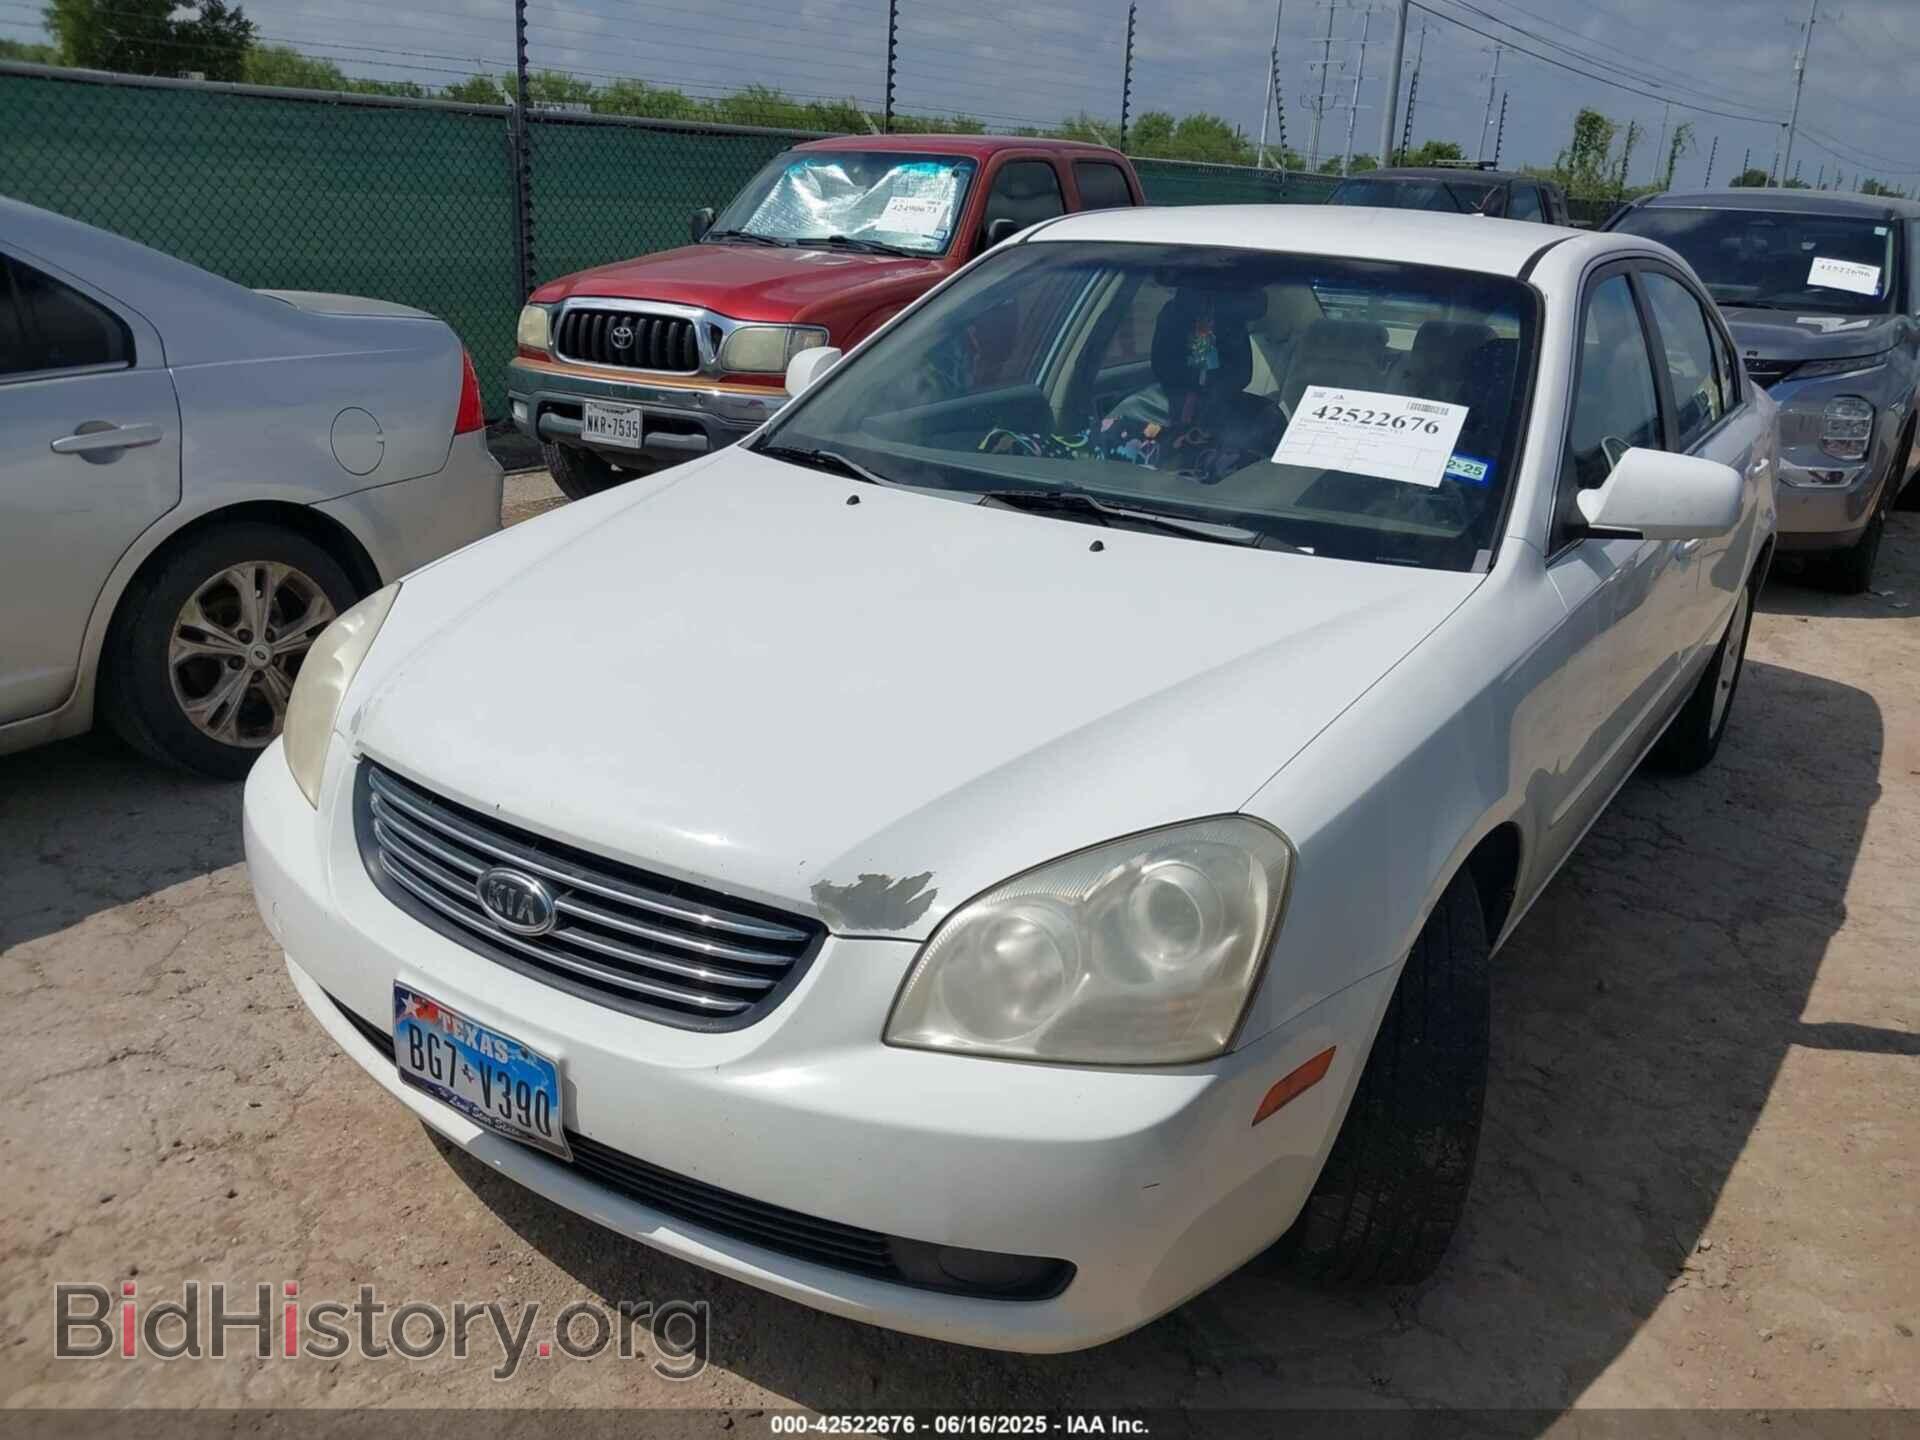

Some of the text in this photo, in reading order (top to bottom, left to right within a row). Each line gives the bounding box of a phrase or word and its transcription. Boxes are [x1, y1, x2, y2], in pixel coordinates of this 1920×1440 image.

[1312, 404, 1440, 435] 42522676
[488, 879, 536, 924] KIA
[440, 1010, 509, 1063] TEXAS
